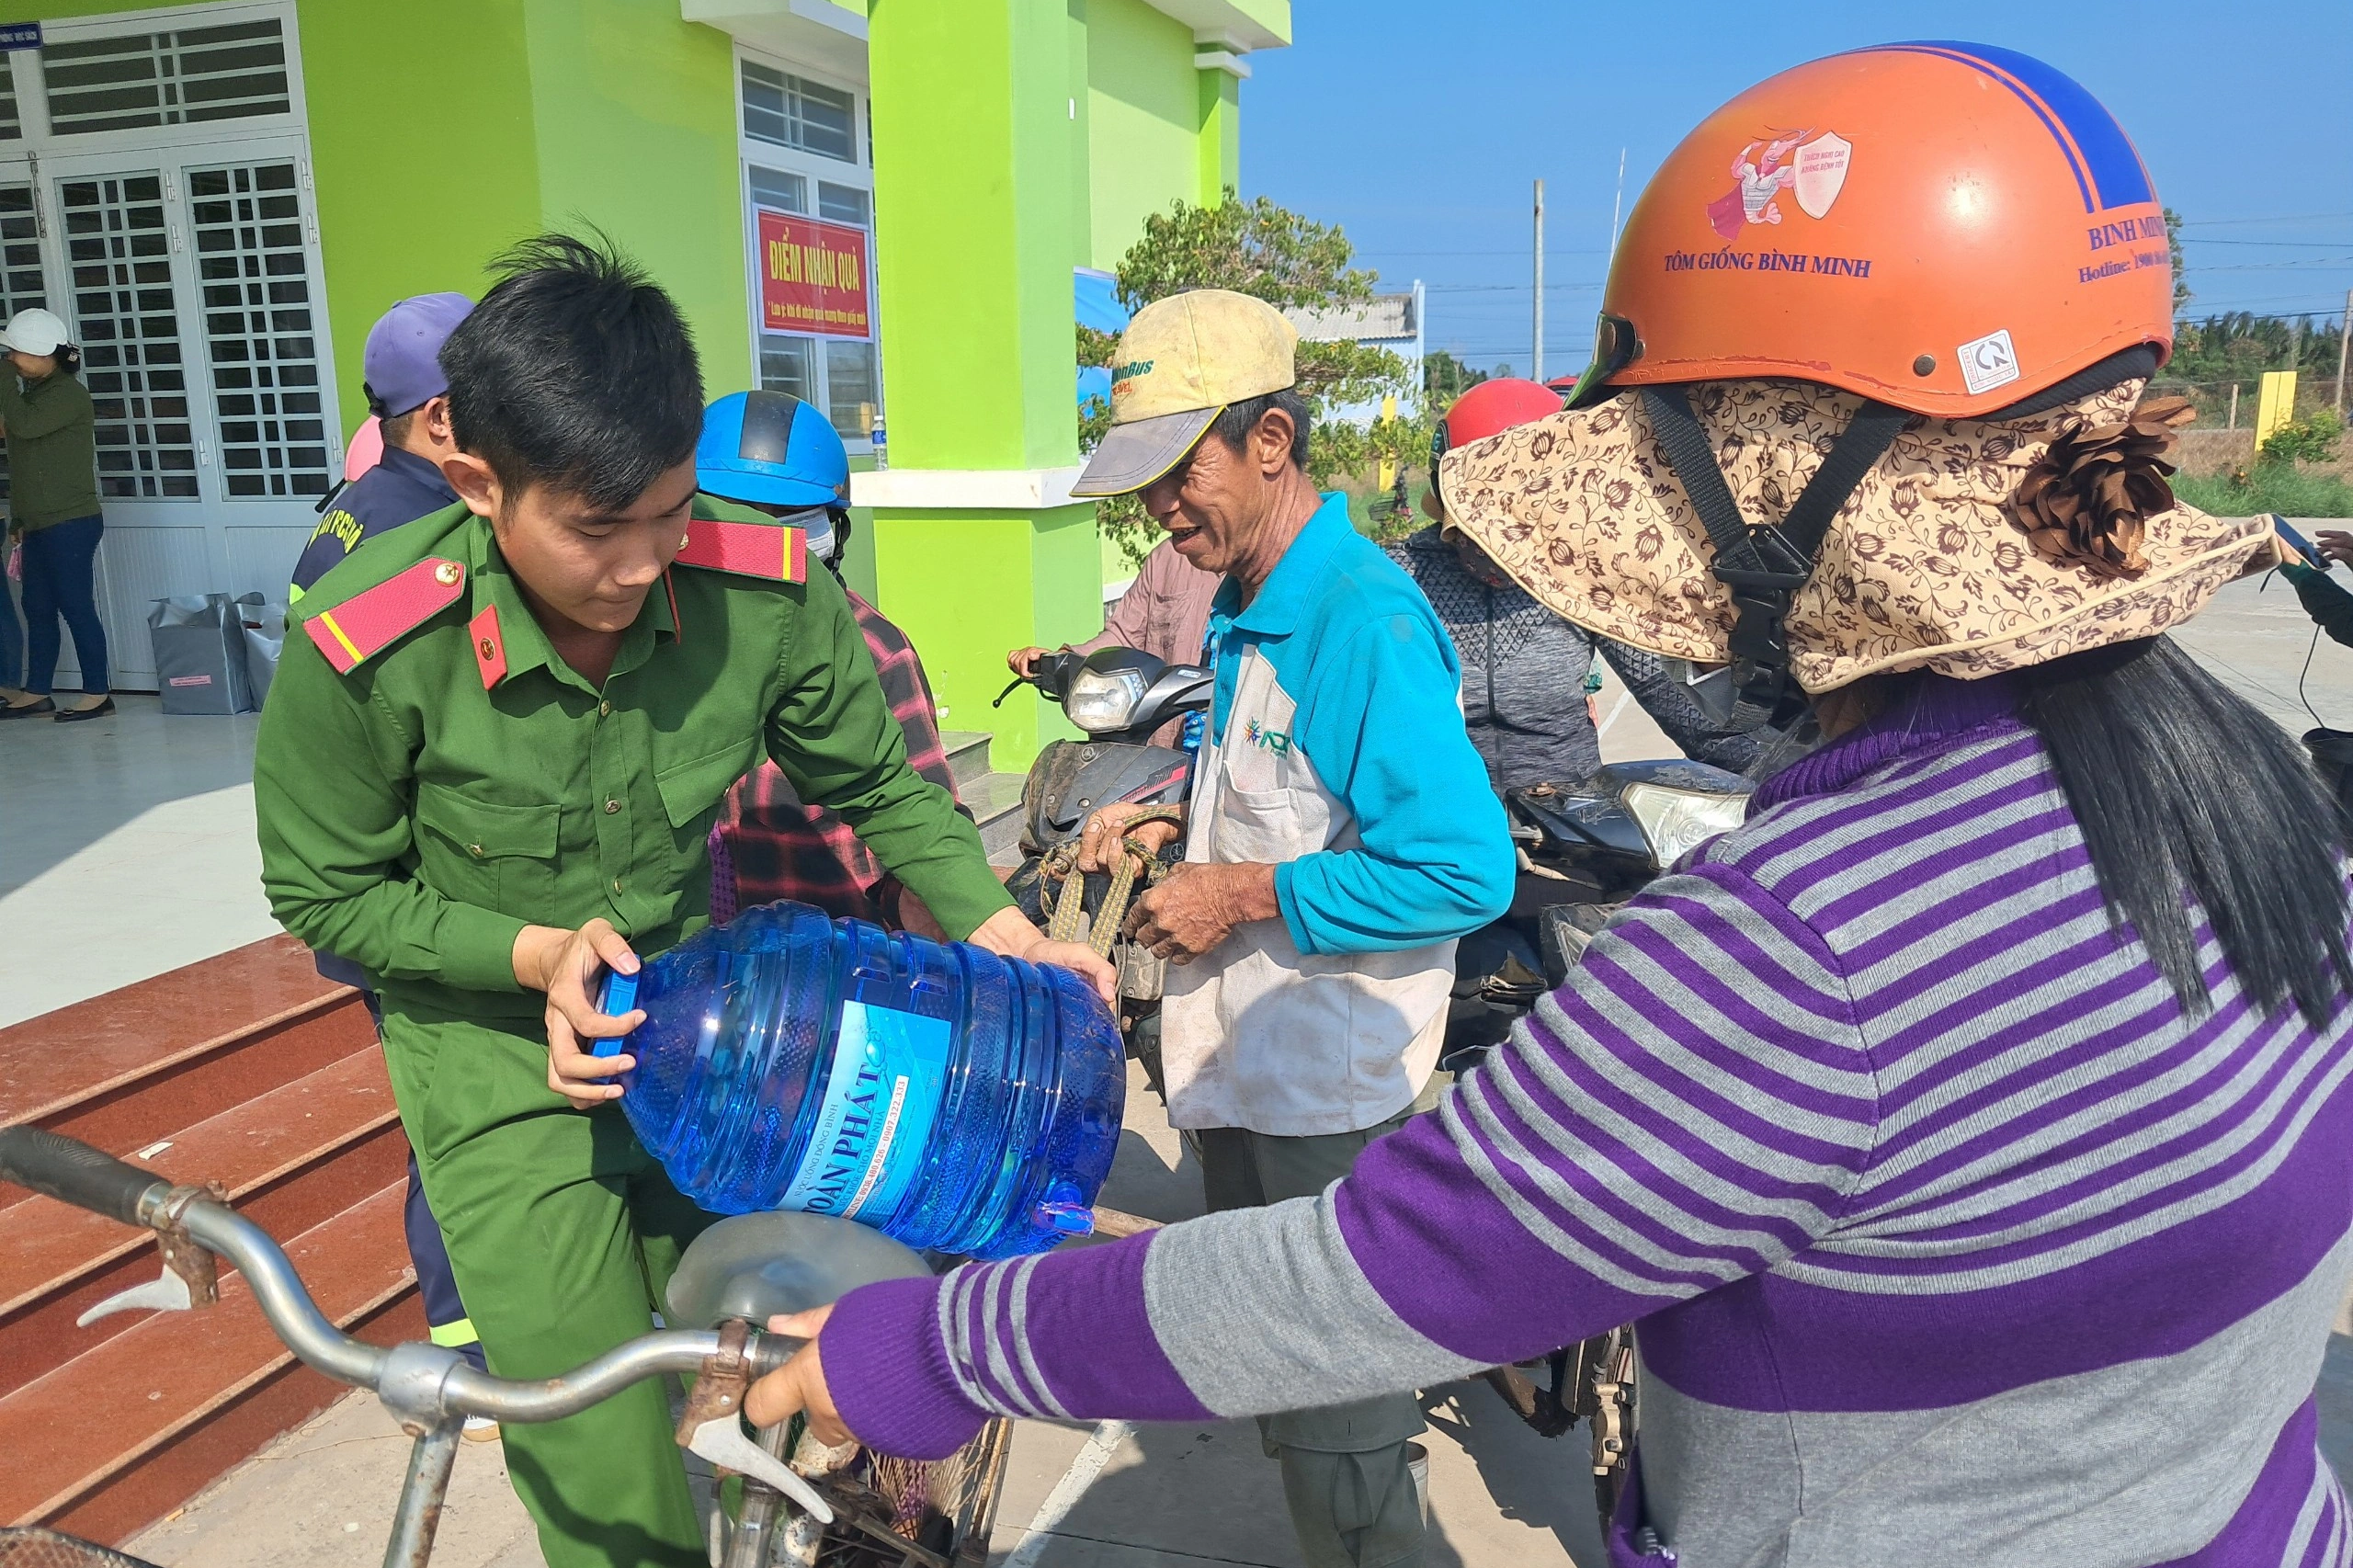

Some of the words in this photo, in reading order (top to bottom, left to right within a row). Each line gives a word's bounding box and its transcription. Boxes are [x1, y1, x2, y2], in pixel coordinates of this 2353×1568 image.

[769, 226, 801, 283] ĐIỂM
[804, 241, 835, 295] NHẬN
[838, 246, 859, 294] QUÀ
[1665, 248, 1695, 272] TÔM
[1699, 244, 1753, 270] GIỐNG
[1758, 248, 1806, 272] BÌNH
[1811, 256, 1871, 278] MINH
[2078, 261, 2130, 282] Hotline:
[831, 1062, 881, 1159] PHÁT
[872, 1110, 885, 1131] NHÀ
[881, 1081, 905, 1142] 0907.322.333
[813, 1131, 829, 1155] ĐÓNG
[824, 1104, 838, 1129] BÌNH
[867, 1132, 880, 1153] MỌI
[859, 1154, 870, 1173] CHO
